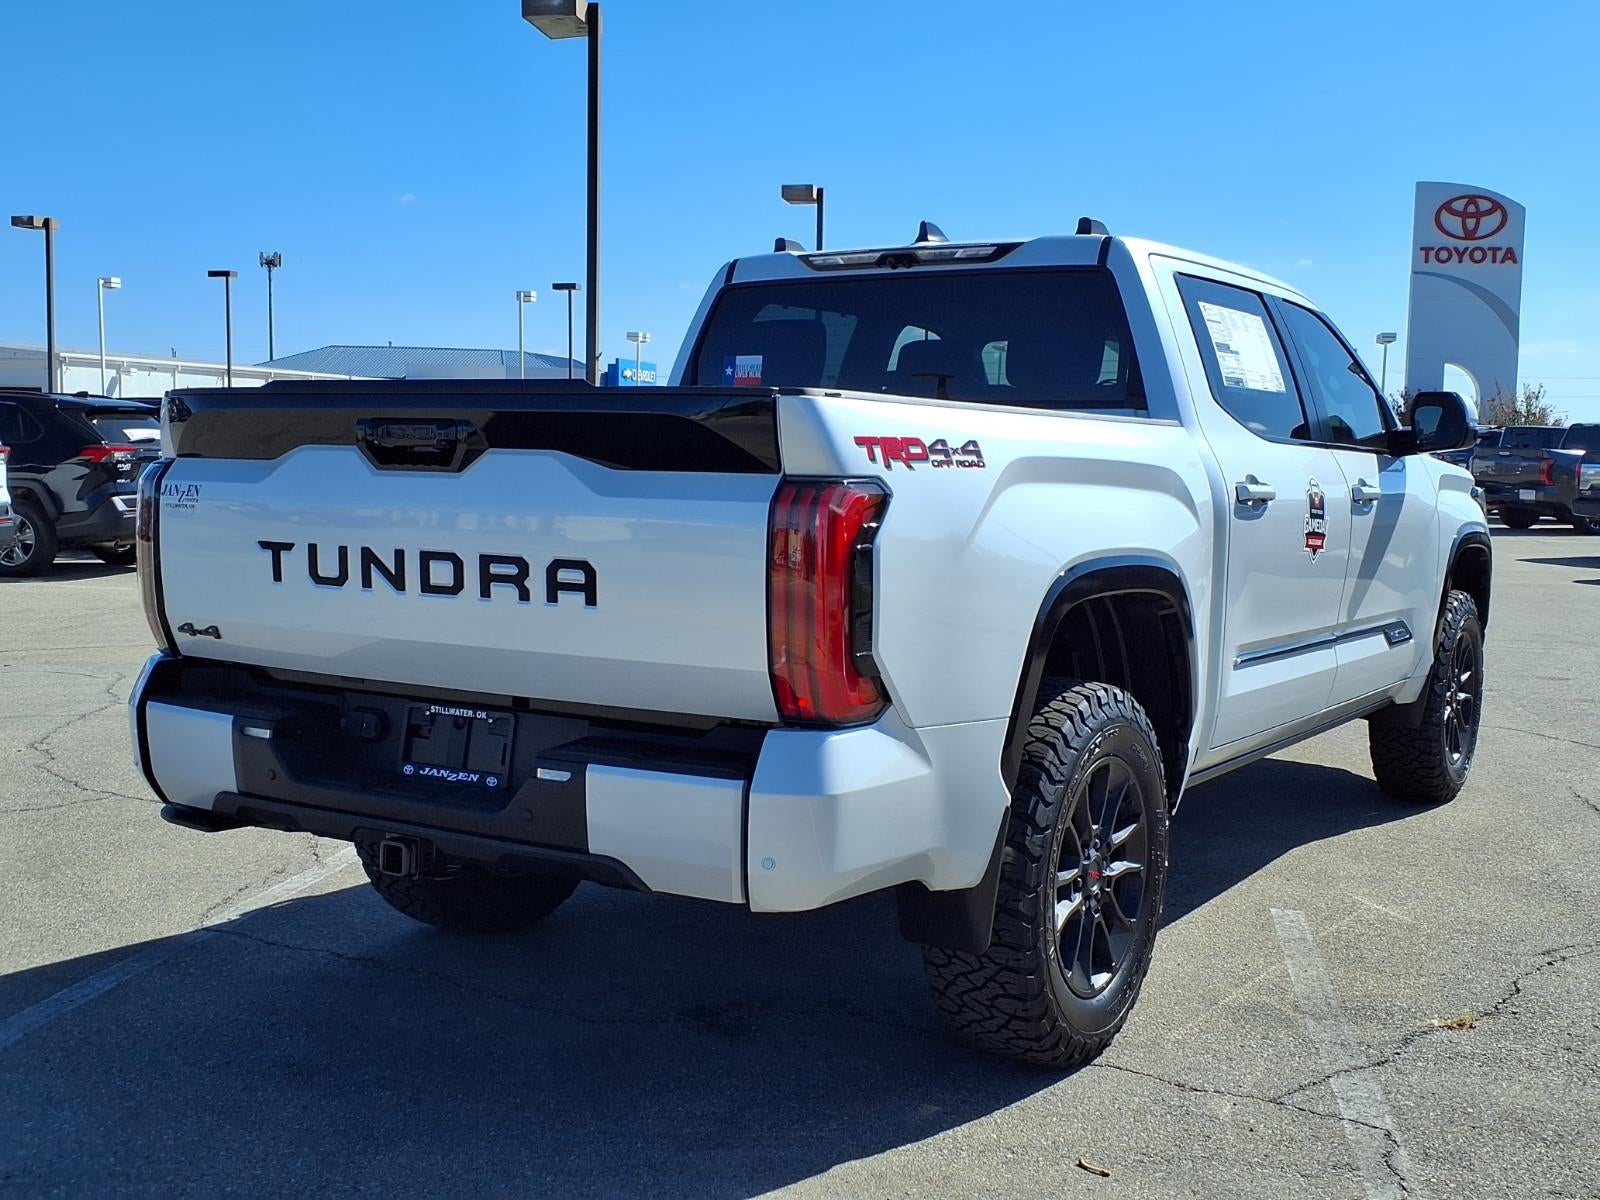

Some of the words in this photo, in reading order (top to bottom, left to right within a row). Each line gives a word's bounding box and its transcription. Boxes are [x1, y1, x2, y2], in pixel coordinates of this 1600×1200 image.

[1420, 246, 1518, 264] TOYOTA
[853, 436, 929, 471] TRD
[927, 438, 984, 460] 4x4
[931, 459, 954, 468] OFF
[956, 459, 986, 469] ROAD
[161, 484, 202, 502] JANZEN
[257, 540, 597, 608] TUNDRA
[177, 622, 222, 640] 4x4
[476, 711, 487, 720] OK
[419, 767, 480, 782] JANZEN
